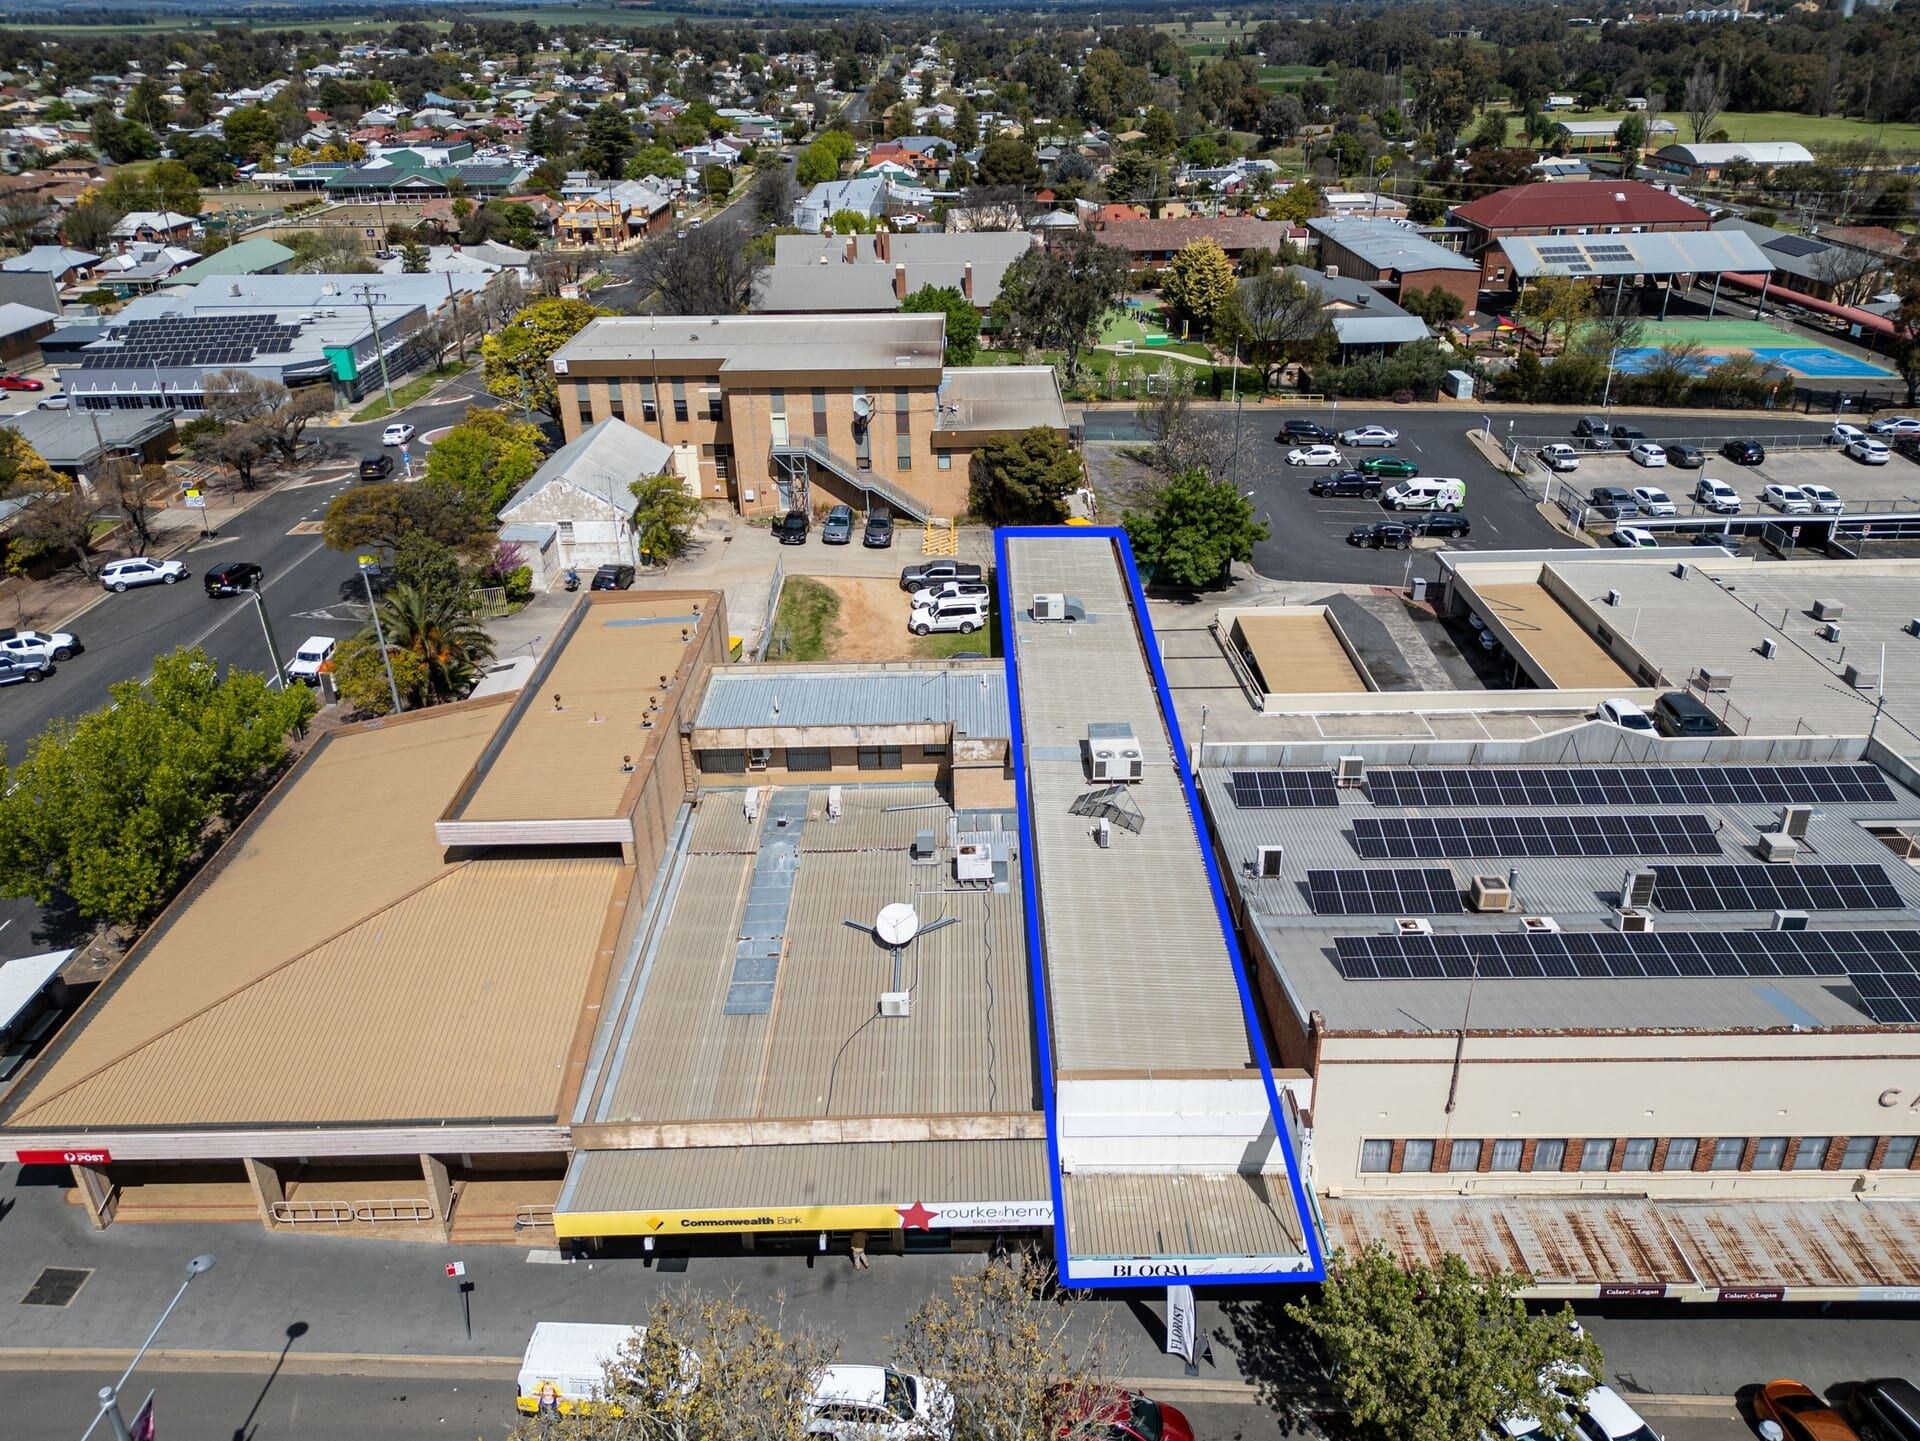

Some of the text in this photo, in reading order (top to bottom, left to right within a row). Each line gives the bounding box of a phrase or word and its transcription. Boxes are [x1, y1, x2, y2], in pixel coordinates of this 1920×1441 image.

[77, 1154, 104, 1162] POST
[940, 1206, 998, 1219] rourke
[1004, 1205, 1055, 1219] henry
[680, 1216, 802, 1227] Commonwealth Bank
[1113, 1264, 1188, 1277] BLOOM
[1171, 1304, 1184, 1350] FLORIST
